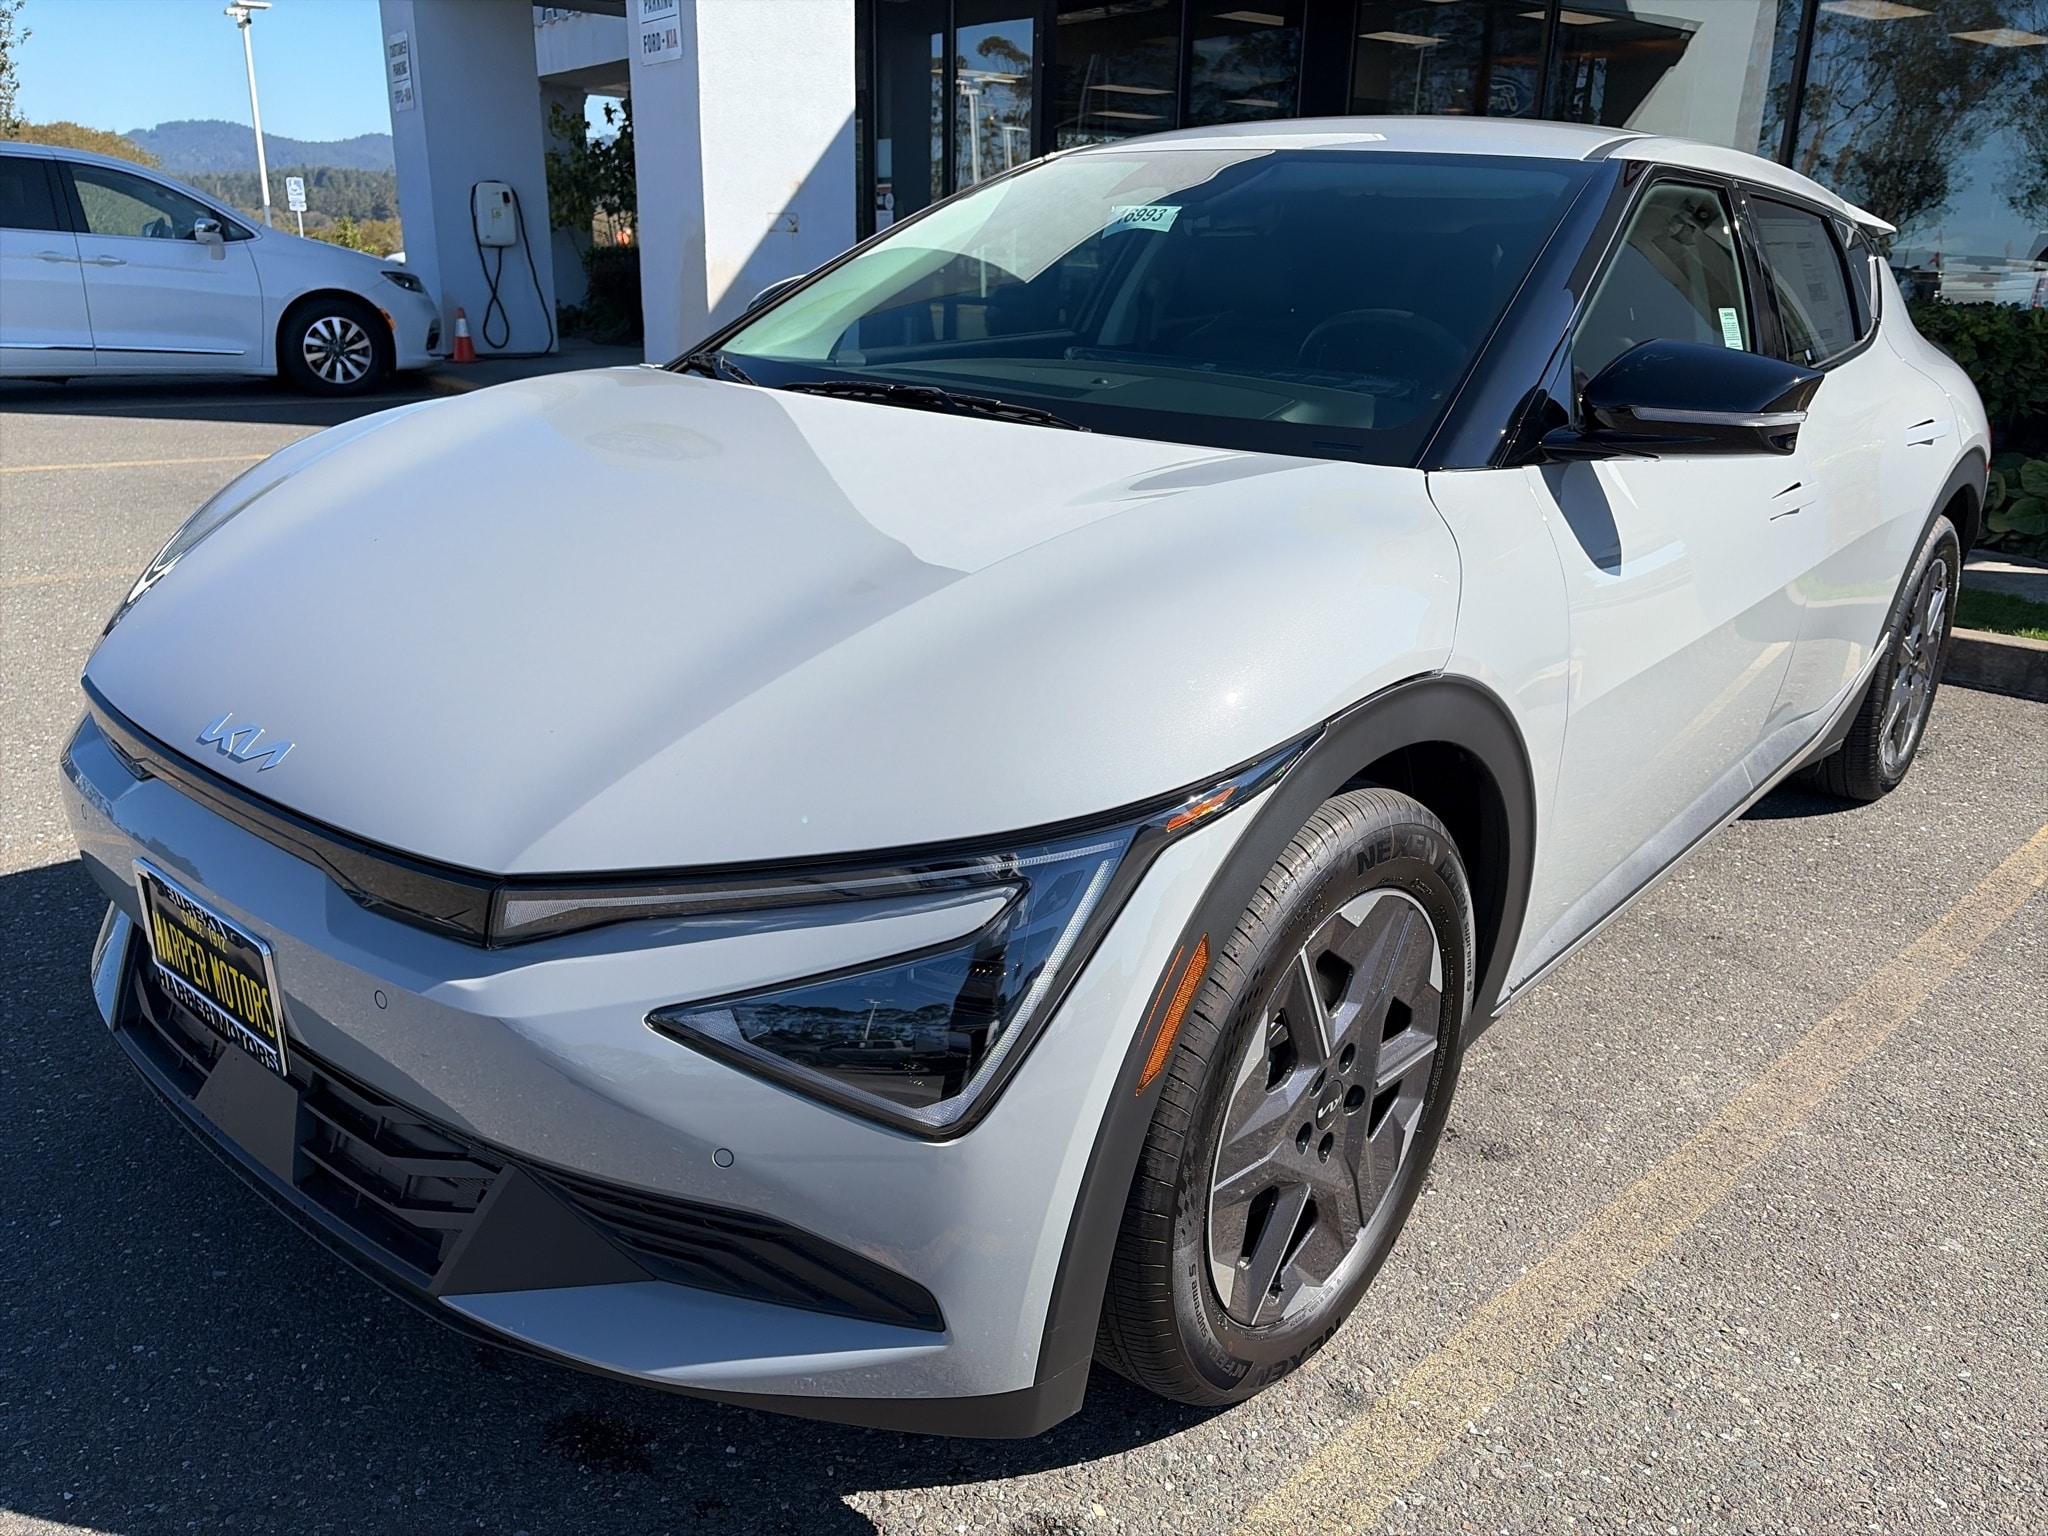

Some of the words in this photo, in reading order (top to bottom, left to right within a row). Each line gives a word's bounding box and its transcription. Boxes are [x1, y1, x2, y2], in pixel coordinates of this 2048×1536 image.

[196, 711, 296, 773] KIA
[1356, 834, 1439, 878] NEXEN
[180, 909, 206, 938] SINCE
[207, 926, 229, 954] 1912
[152, 911, 212, 993] HARPER
[208, 952, 275, 1038] MOTORS
[1188, 1263, 1197, 1278] S
[1191, 1281, 1209, 1338] supreme
